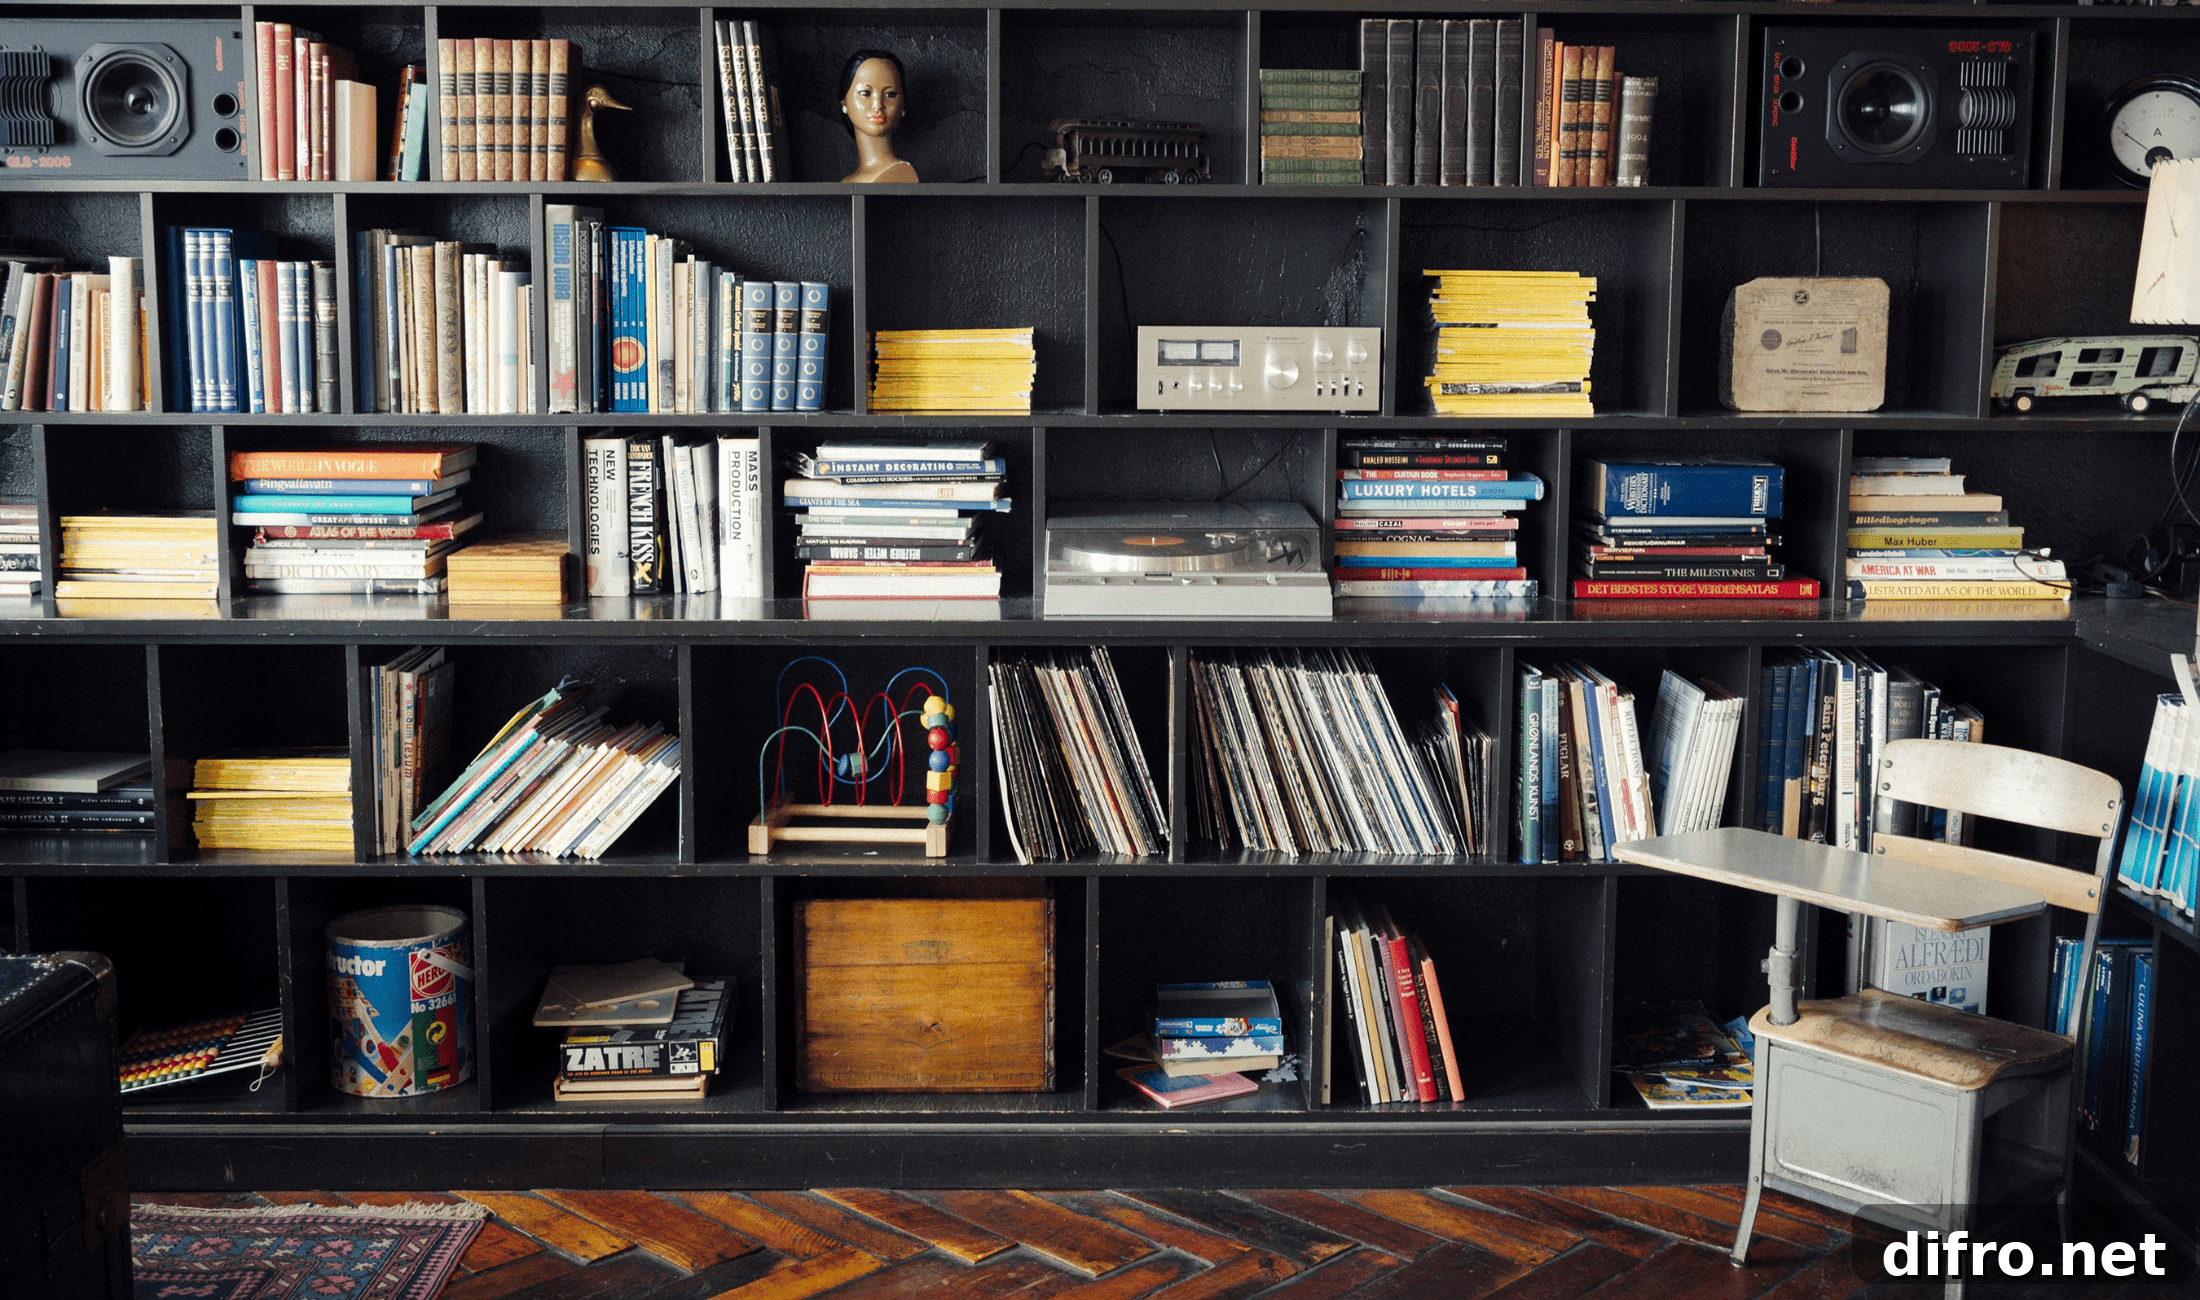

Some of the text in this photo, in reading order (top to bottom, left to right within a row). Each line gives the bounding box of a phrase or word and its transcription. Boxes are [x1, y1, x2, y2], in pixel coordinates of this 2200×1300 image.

[1626, 134, 1649, 143] 1904
[2153, 128, 2162, 137] A
[579, 230, 588, 273] POSSESSIONS
[420, 286, 429, 316] Outline
[732, 285, 742, 351] American Cocker Spaniel
[418, 332, 431, 378] Physiology
[318, 459, 332, 472] IN
[334, 459, 378, 472] VOGUE
[605, 450, 615, 481] NEW
[1363, 456, 1384, 464] KHALED
[1384, 456, 1409, 464] HOSSEINI
[748, 450, 757, 492] MASS
[1365, 470, 1377, 478] THE
[1393, 470, 1419, 479] CURTAIN
[1420, 470, 1438, 479] BOOK
[731, 450, 741, 540] PRODUCTION
[1354, 484, 1477, 497] LUXURY HOTELS
[1640, 471, 1649, 514] DICTIONARY
[1753, 477, 1765, 513] TRIDENT
[588, 450, 600, 555] TECHNOLOGIES
[799, 498, 860, 507] GIANTS OF THE SEA
[629, 461, 654, 563] FRENCH KISS
[311, 516, 388, 524] GREAT APE ODYSSEY
[1855, 515, 1939, 525] Billedkogebogen
[309, 527, 417, 537] ATLAS OF THE WORLD
[291, 540, 307, 548] ASIA
[1884, 537, 1937, 546] Max Huber
[863, 547, 888, 560] WEYER
[889, 547, 921, 560] HELFRIED
[279, 564, 381, 578] DICTIONARY
[1664, 568, 1756, 577] THE MILESTONES
[1861, 564, 1901, 576] AMERICA
[1902, 564, 1914, 576] AT
[1915, 564, 1937, 576] WAR
[1587, 584, 1779, 594] DET BEDSTES STORE VERDENSATLAS
[1924, 587, 1959, 596] ATLAS
[1959, 587, 1971, 596] OF
[1973, 587, 1996, 596] THE
[1998, 587, 2037, 596] WORLD
[1842, 682, 1854, 720] GUINNESS
[1929, 697, 1938, 733] Mine Eyes
[1842, 722, 1854, 744] BOOK
[1624, 710, 1641, 775] REFLECTIONS
[1558, 732, 1570, 779] FUGLAR
[1812, 695, 1834, 806] Saint Petersburg
[1842, 746, 1854, 755] OF
[1527, 712, 1539, 822] GRØNLANDS KUNST
[1895, 937, 1985, 969] ALFRÆÐI
[410, 1001, 426, 1014] No
[1254, 1023, 1279, 1035] Disney
[566, 1045, 660, 1071] ZATRE
[2128, 983, 2147, 1130] CULINA MEDITERRANEA
